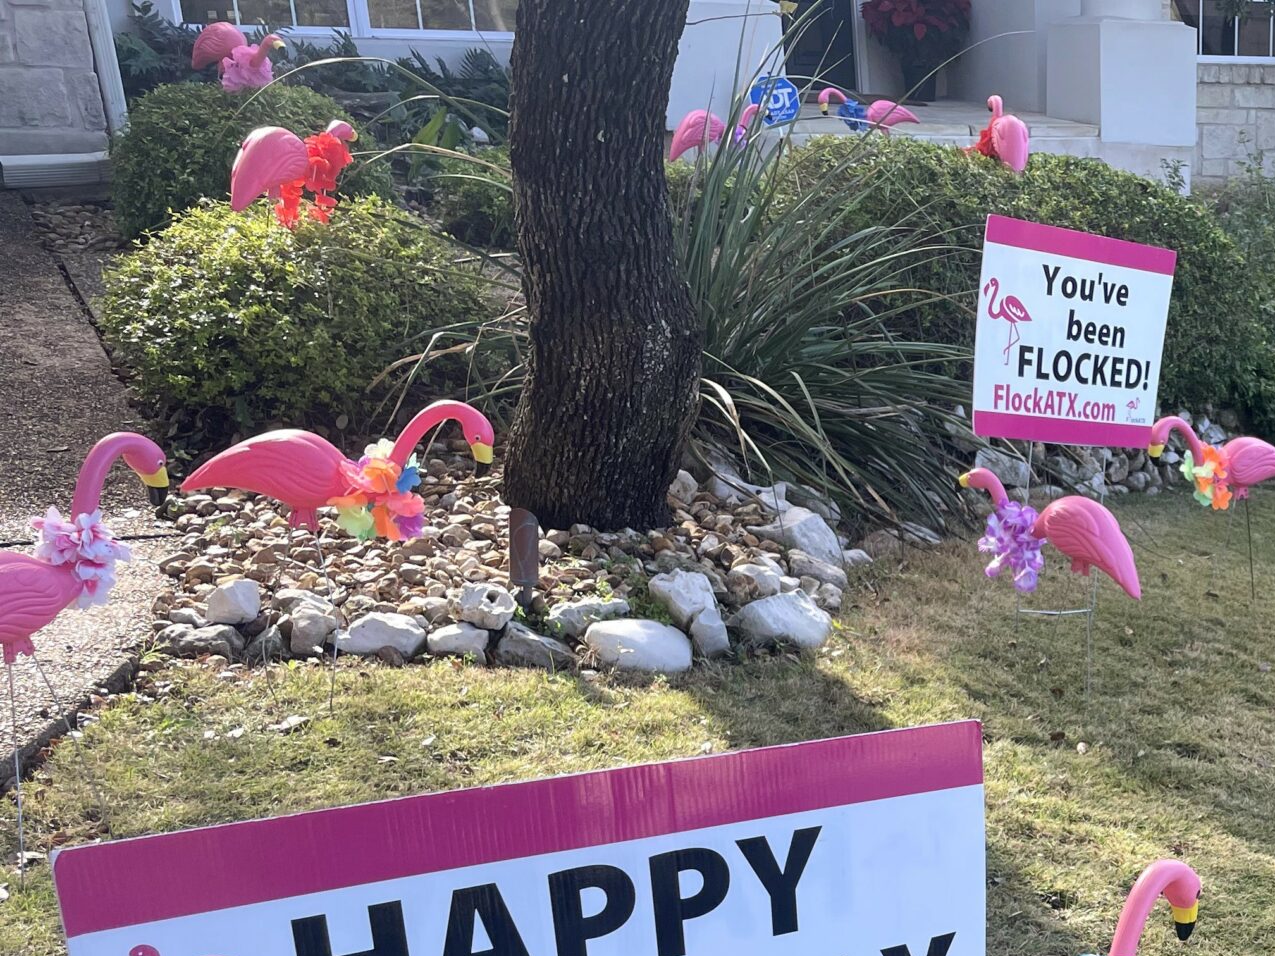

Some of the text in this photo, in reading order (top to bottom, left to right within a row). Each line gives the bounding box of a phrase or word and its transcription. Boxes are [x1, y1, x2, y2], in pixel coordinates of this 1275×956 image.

[1042, 264, 1129, 306] You've
[1066, 309, 1125, 348] been
[1018, 345, 1150, 391] FLOCKED!
[993, 384, 1115, 421] FlockATX.com
